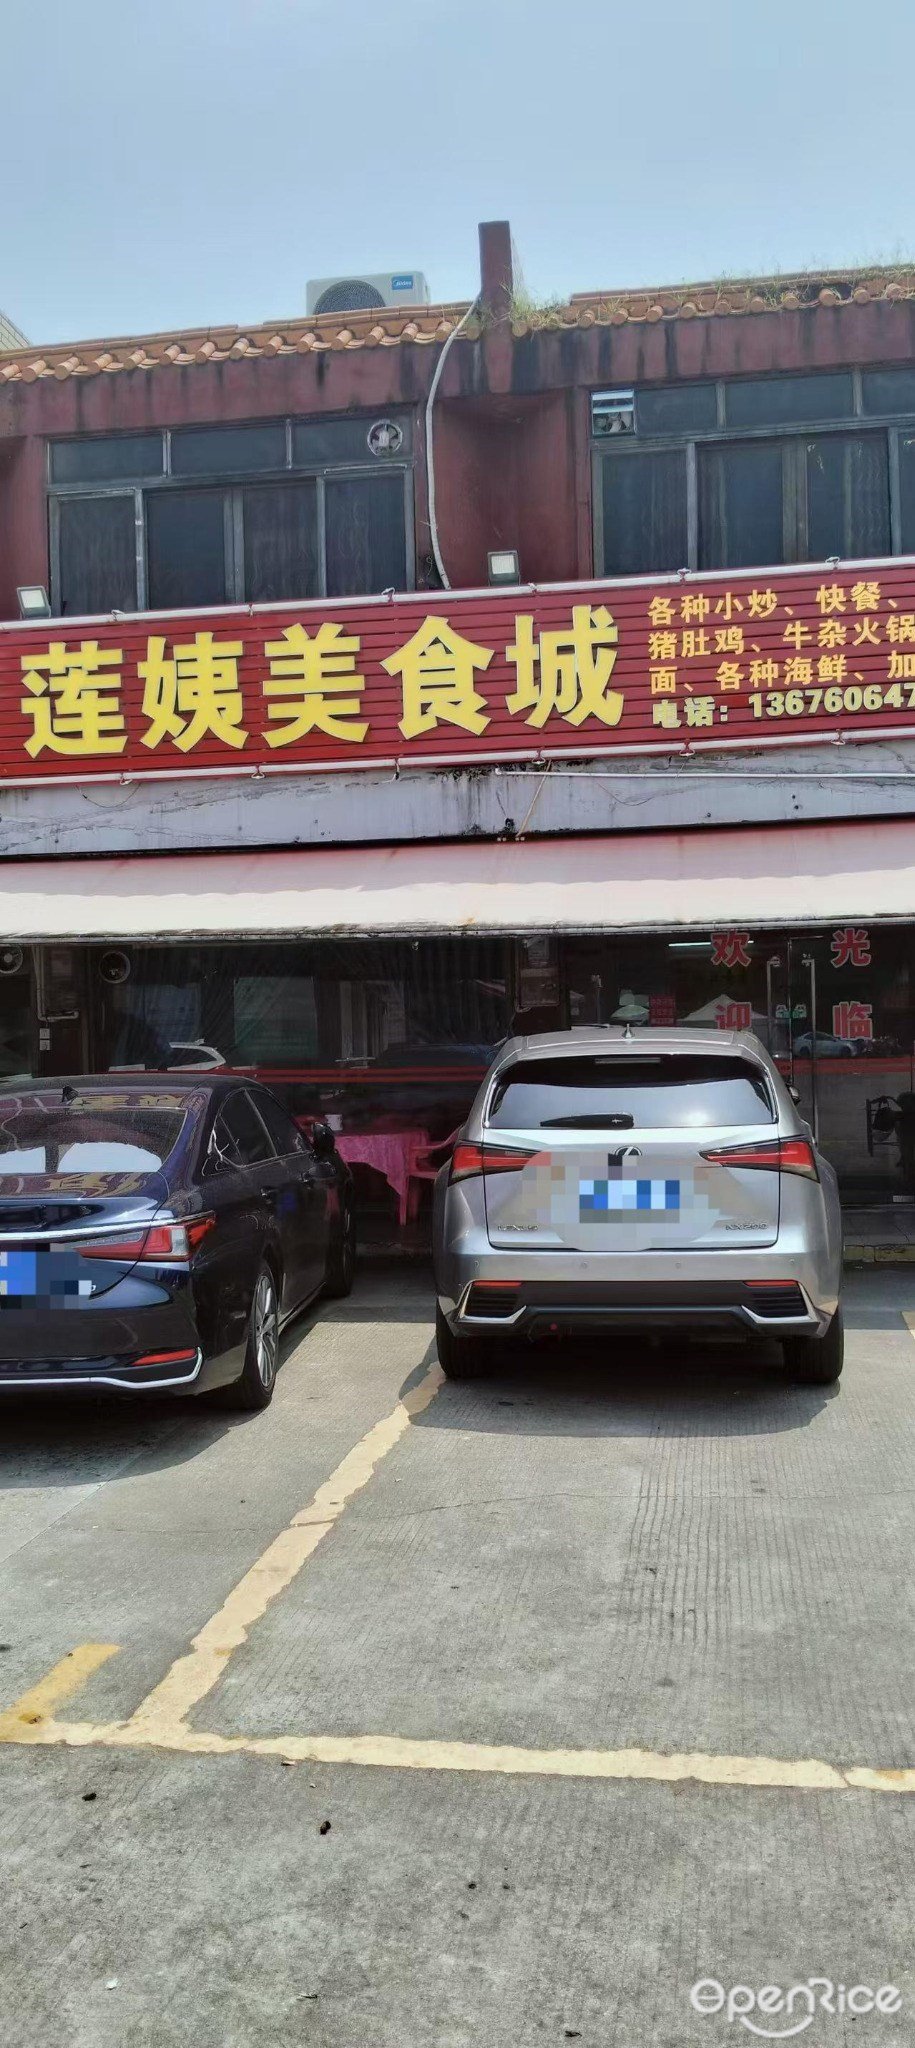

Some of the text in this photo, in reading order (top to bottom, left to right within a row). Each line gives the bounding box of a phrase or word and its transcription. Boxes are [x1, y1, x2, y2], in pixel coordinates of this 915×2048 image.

[20, 604, 624, 758] 莲姨美食城
[649, 614, 915, 660] 猪肚鸡、牛杂火锅
[711, 929, 752, 1031] 欢迎
[831, 928, 873, 1040] 光临
